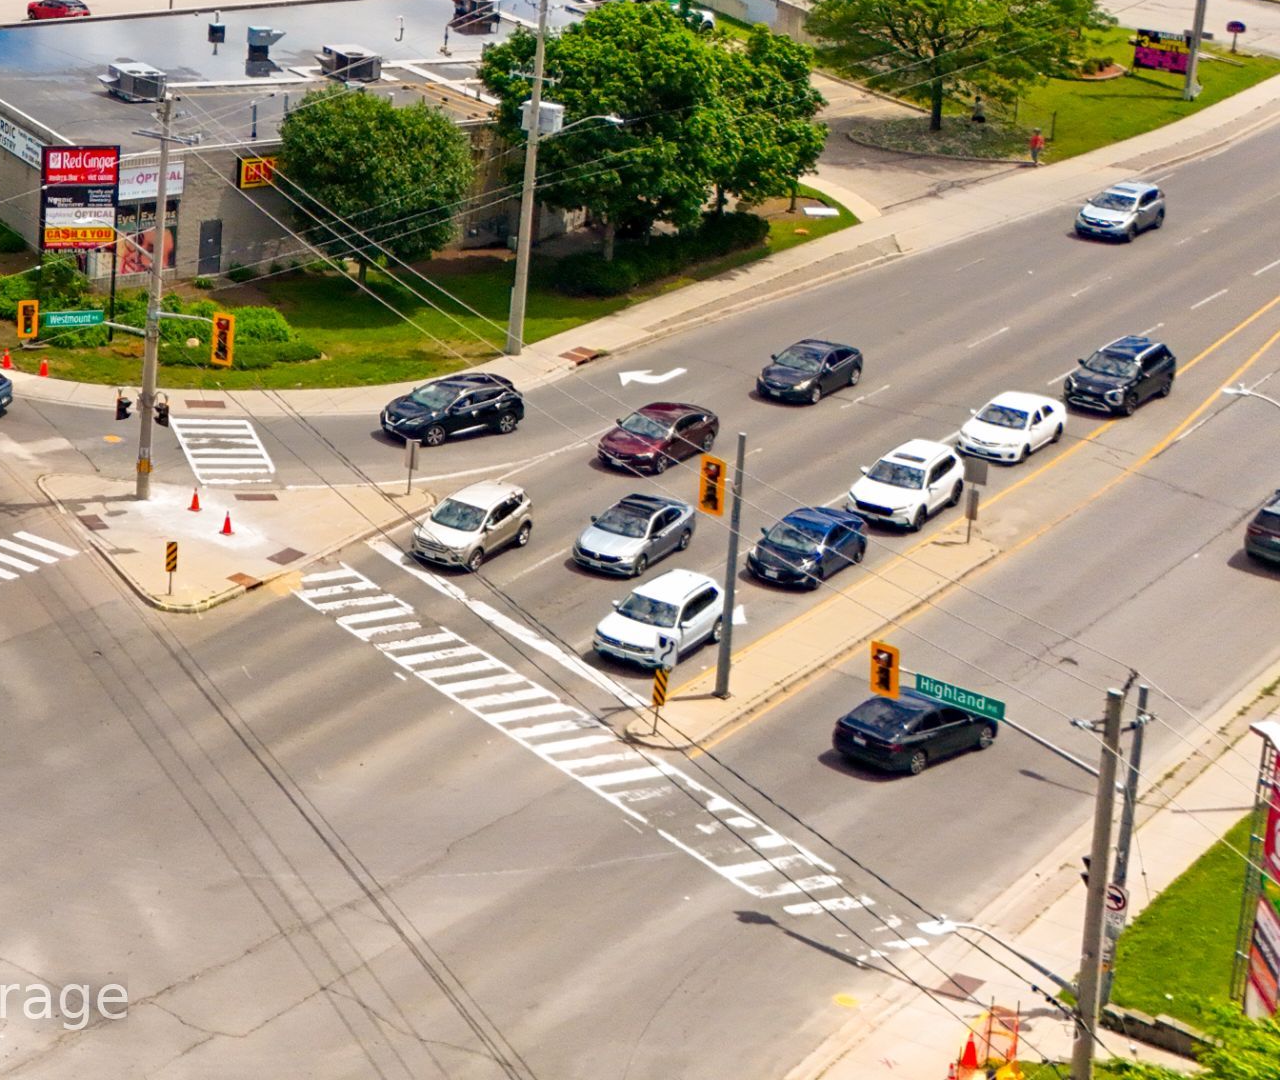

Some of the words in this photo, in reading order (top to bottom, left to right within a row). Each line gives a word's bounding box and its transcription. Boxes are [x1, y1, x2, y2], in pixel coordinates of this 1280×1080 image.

[63, 152, 82, 169] Red
[83, 152, 116, 173] Ginger
[136, 171, 182, 185] OPTAL
[74, 210, 114, 218] OPTICAL
[118, 214, 136, 225] Eye
[81, 230, 87, 238] 4
[90, 230, 111, 238] YOU
[50, 314, 91, 324] Westmount
[921, 677, 986, 710] Highland
